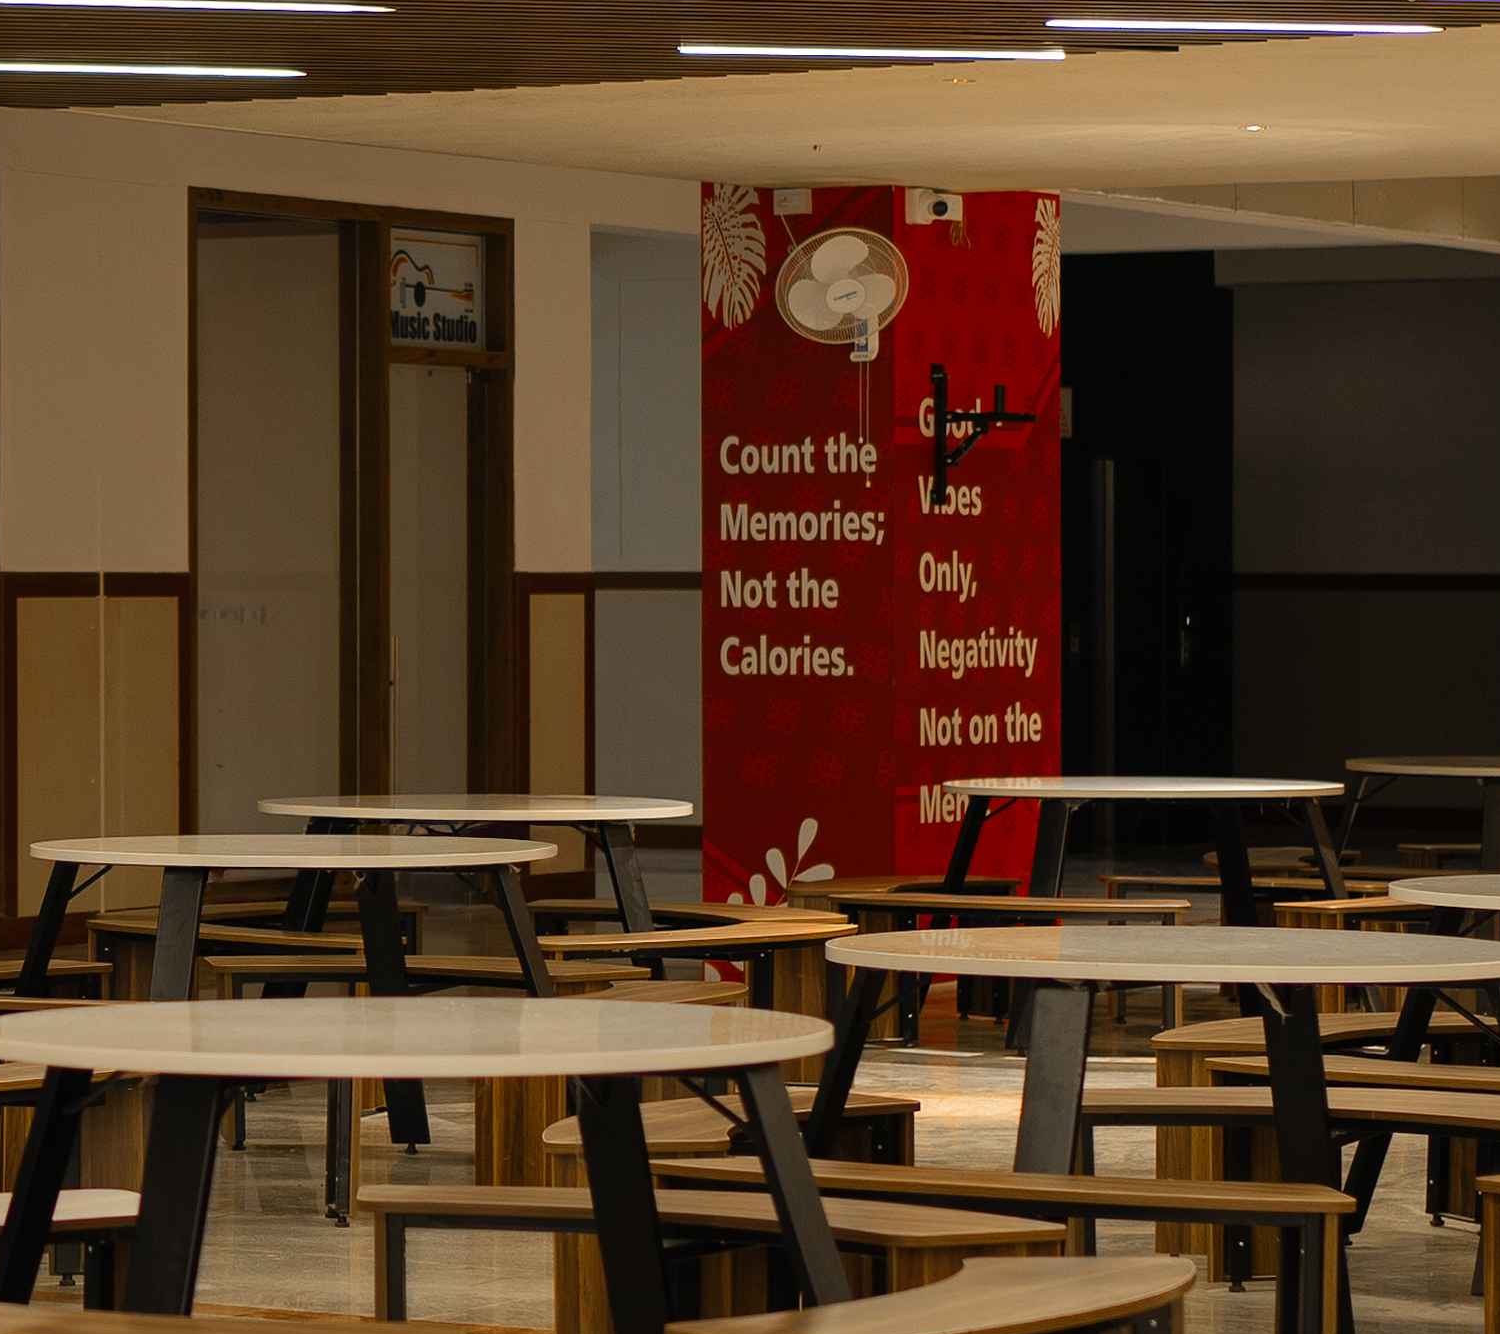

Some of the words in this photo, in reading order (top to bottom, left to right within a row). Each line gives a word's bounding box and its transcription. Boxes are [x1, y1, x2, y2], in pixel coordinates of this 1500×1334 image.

[432, 312, 477, 344] Studio
[719, 435, 815, 475] Count
[824, 431, 878, 474] the
[719, 500, 886, 546] Memories;
[719, 569, 777, 610] Not
[786, 567, 840, 610] the
[919, 550, 978, 603] Only,
[719, 634, 855, 677] Calories.
[919, 625, 1039, 680] Negativity
[919, 707, 962, 747] Not
[969, 713, 999, 745] on
[1004, 701, 1043, 744] the
